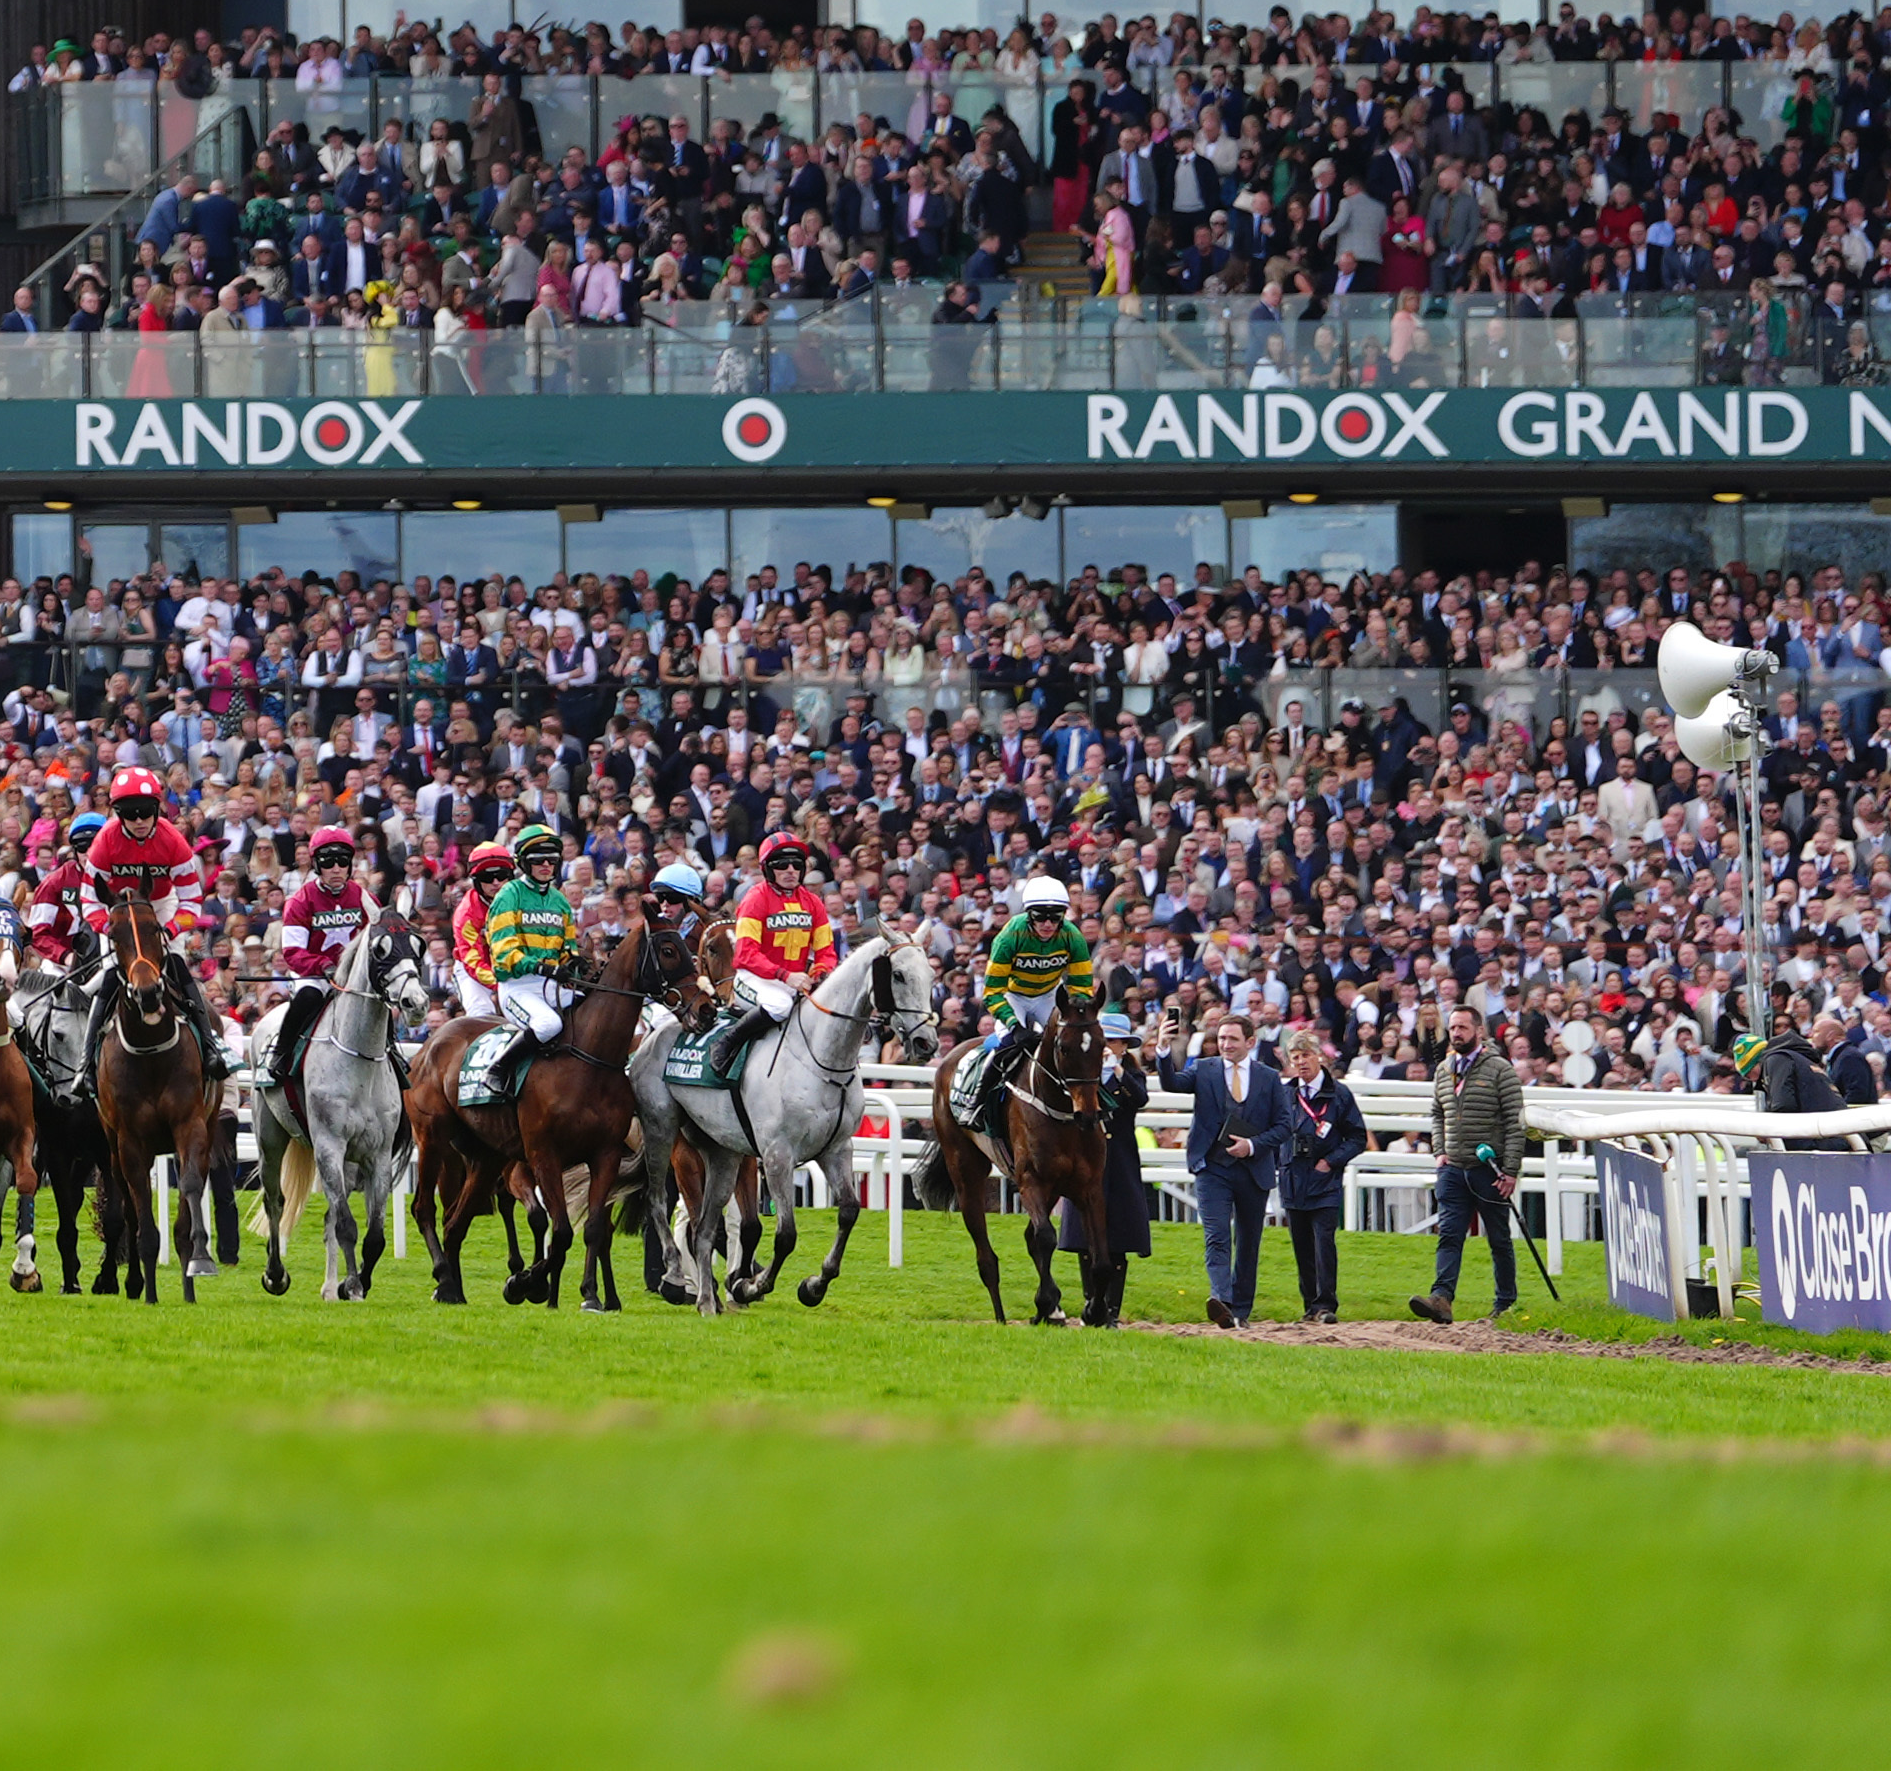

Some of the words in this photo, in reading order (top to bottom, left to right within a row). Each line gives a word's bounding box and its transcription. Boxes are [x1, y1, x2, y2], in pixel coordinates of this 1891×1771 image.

[1088, 391, 1449, 459] RANDOX
[1497, 391, 1809, 457] GRAND
[76, 400, 424, 466] RANDOX
[111, 864, 169, 877] RANOX
[312, 910, 362, 927] RANDOX
[521, 912, 565, 926] RANDOX
[766, 913, 814, 928] RANDOX
[1015, 956, 1069, 970] RANDOX
